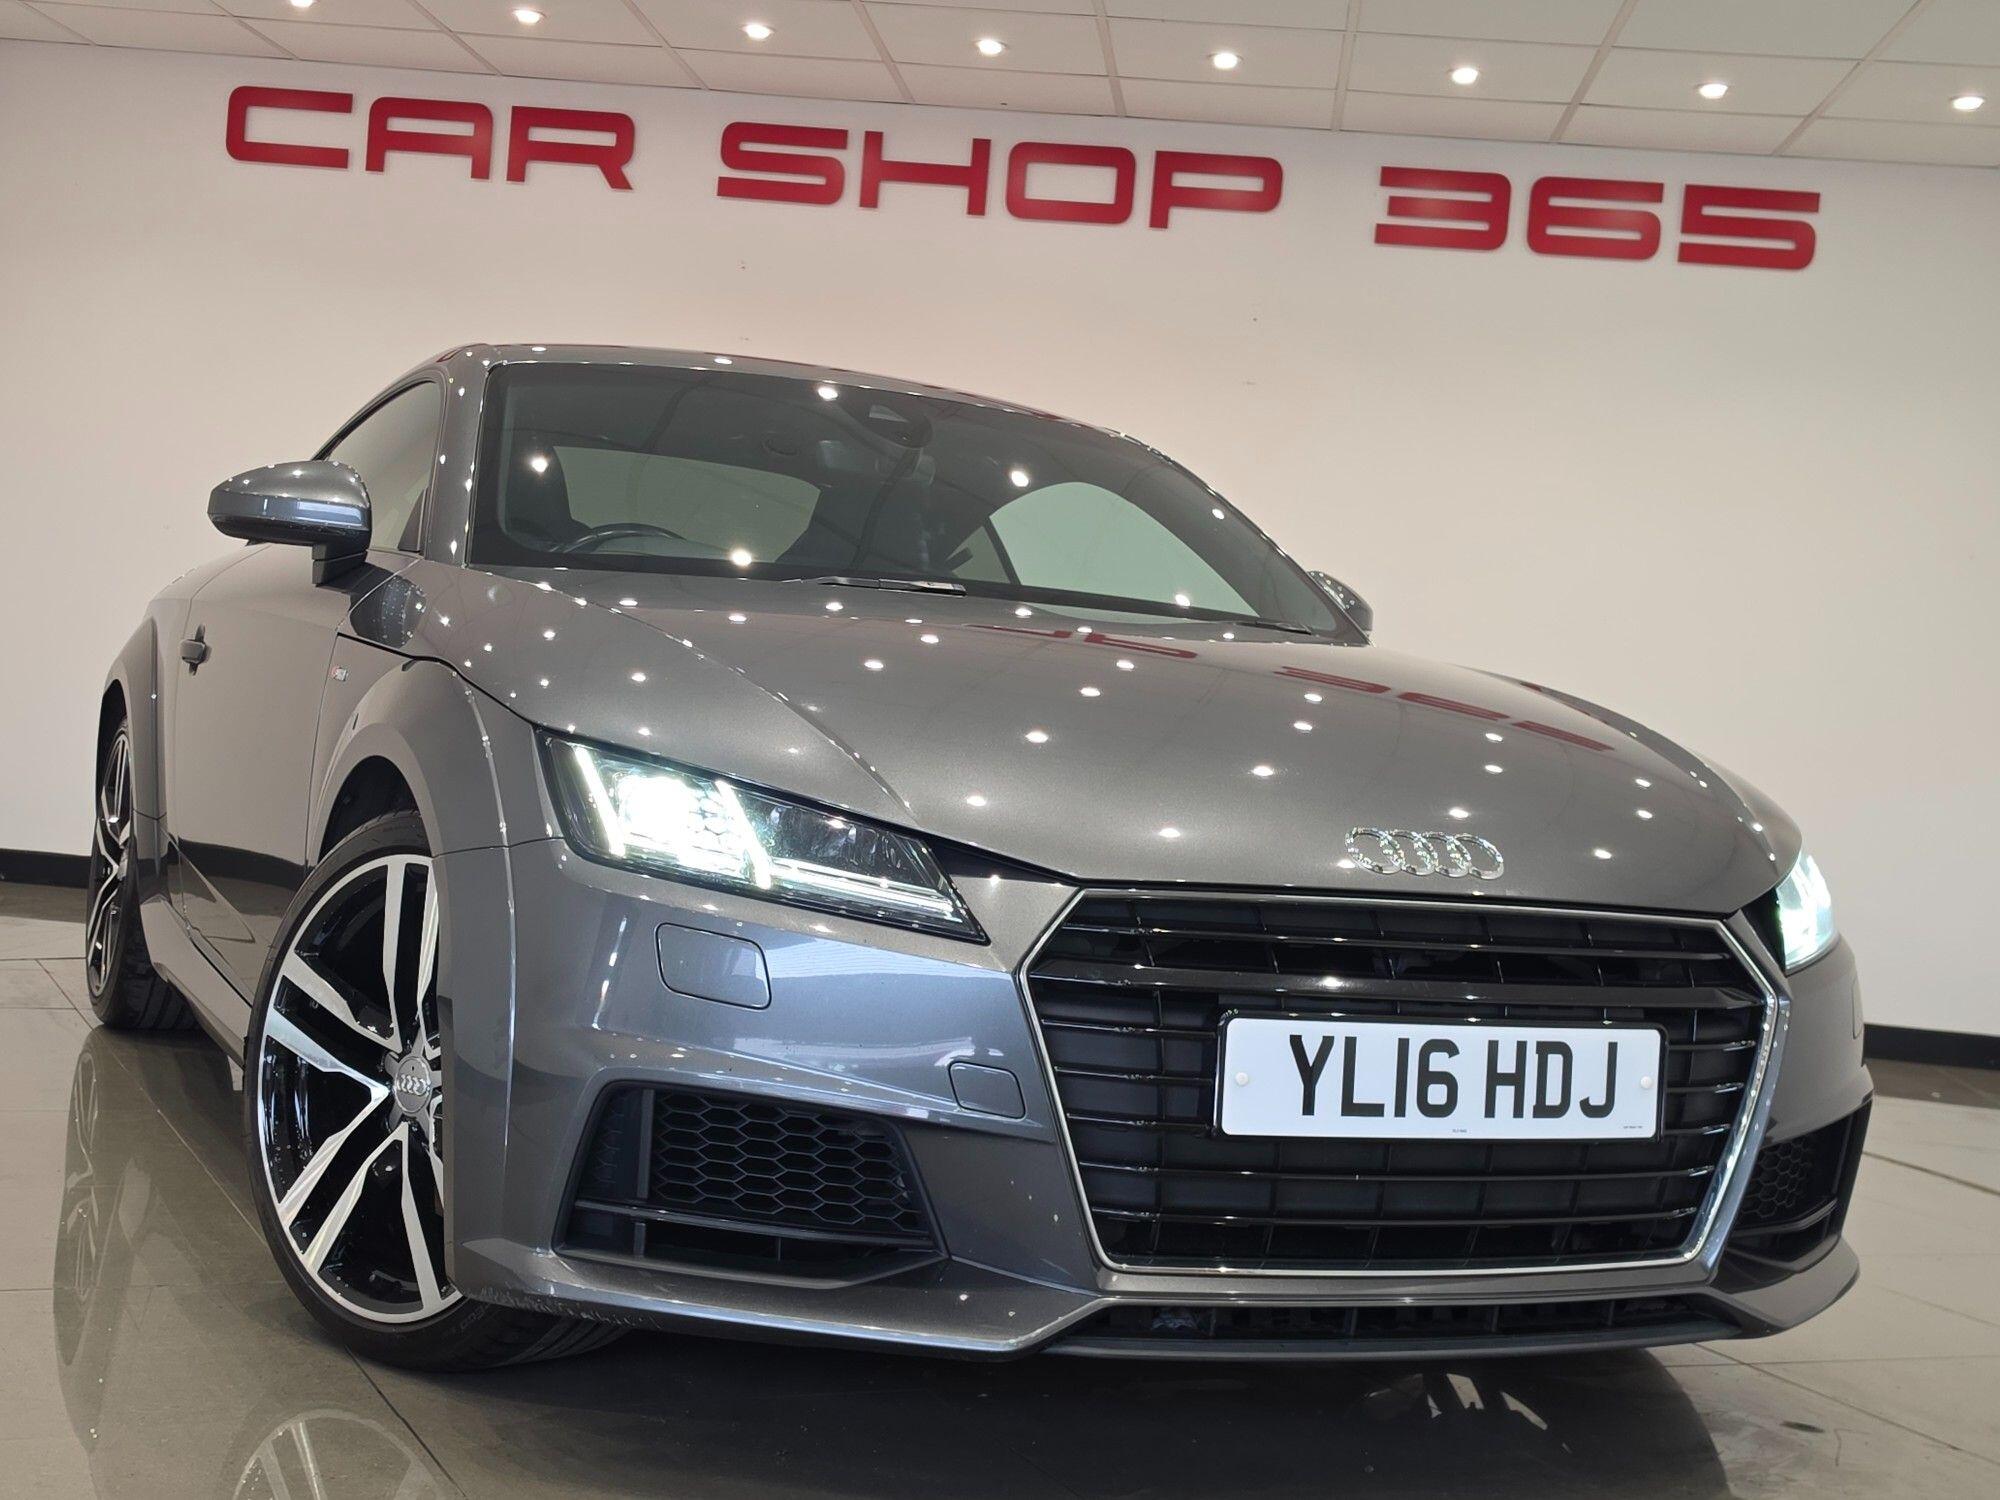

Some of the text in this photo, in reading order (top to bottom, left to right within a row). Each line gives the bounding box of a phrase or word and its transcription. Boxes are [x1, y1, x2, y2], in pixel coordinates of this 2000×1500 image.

[226, 86, 1819, 270] CAR SHOP 365
[1289, 1034, 1618, 1119] YL16 HDJ
